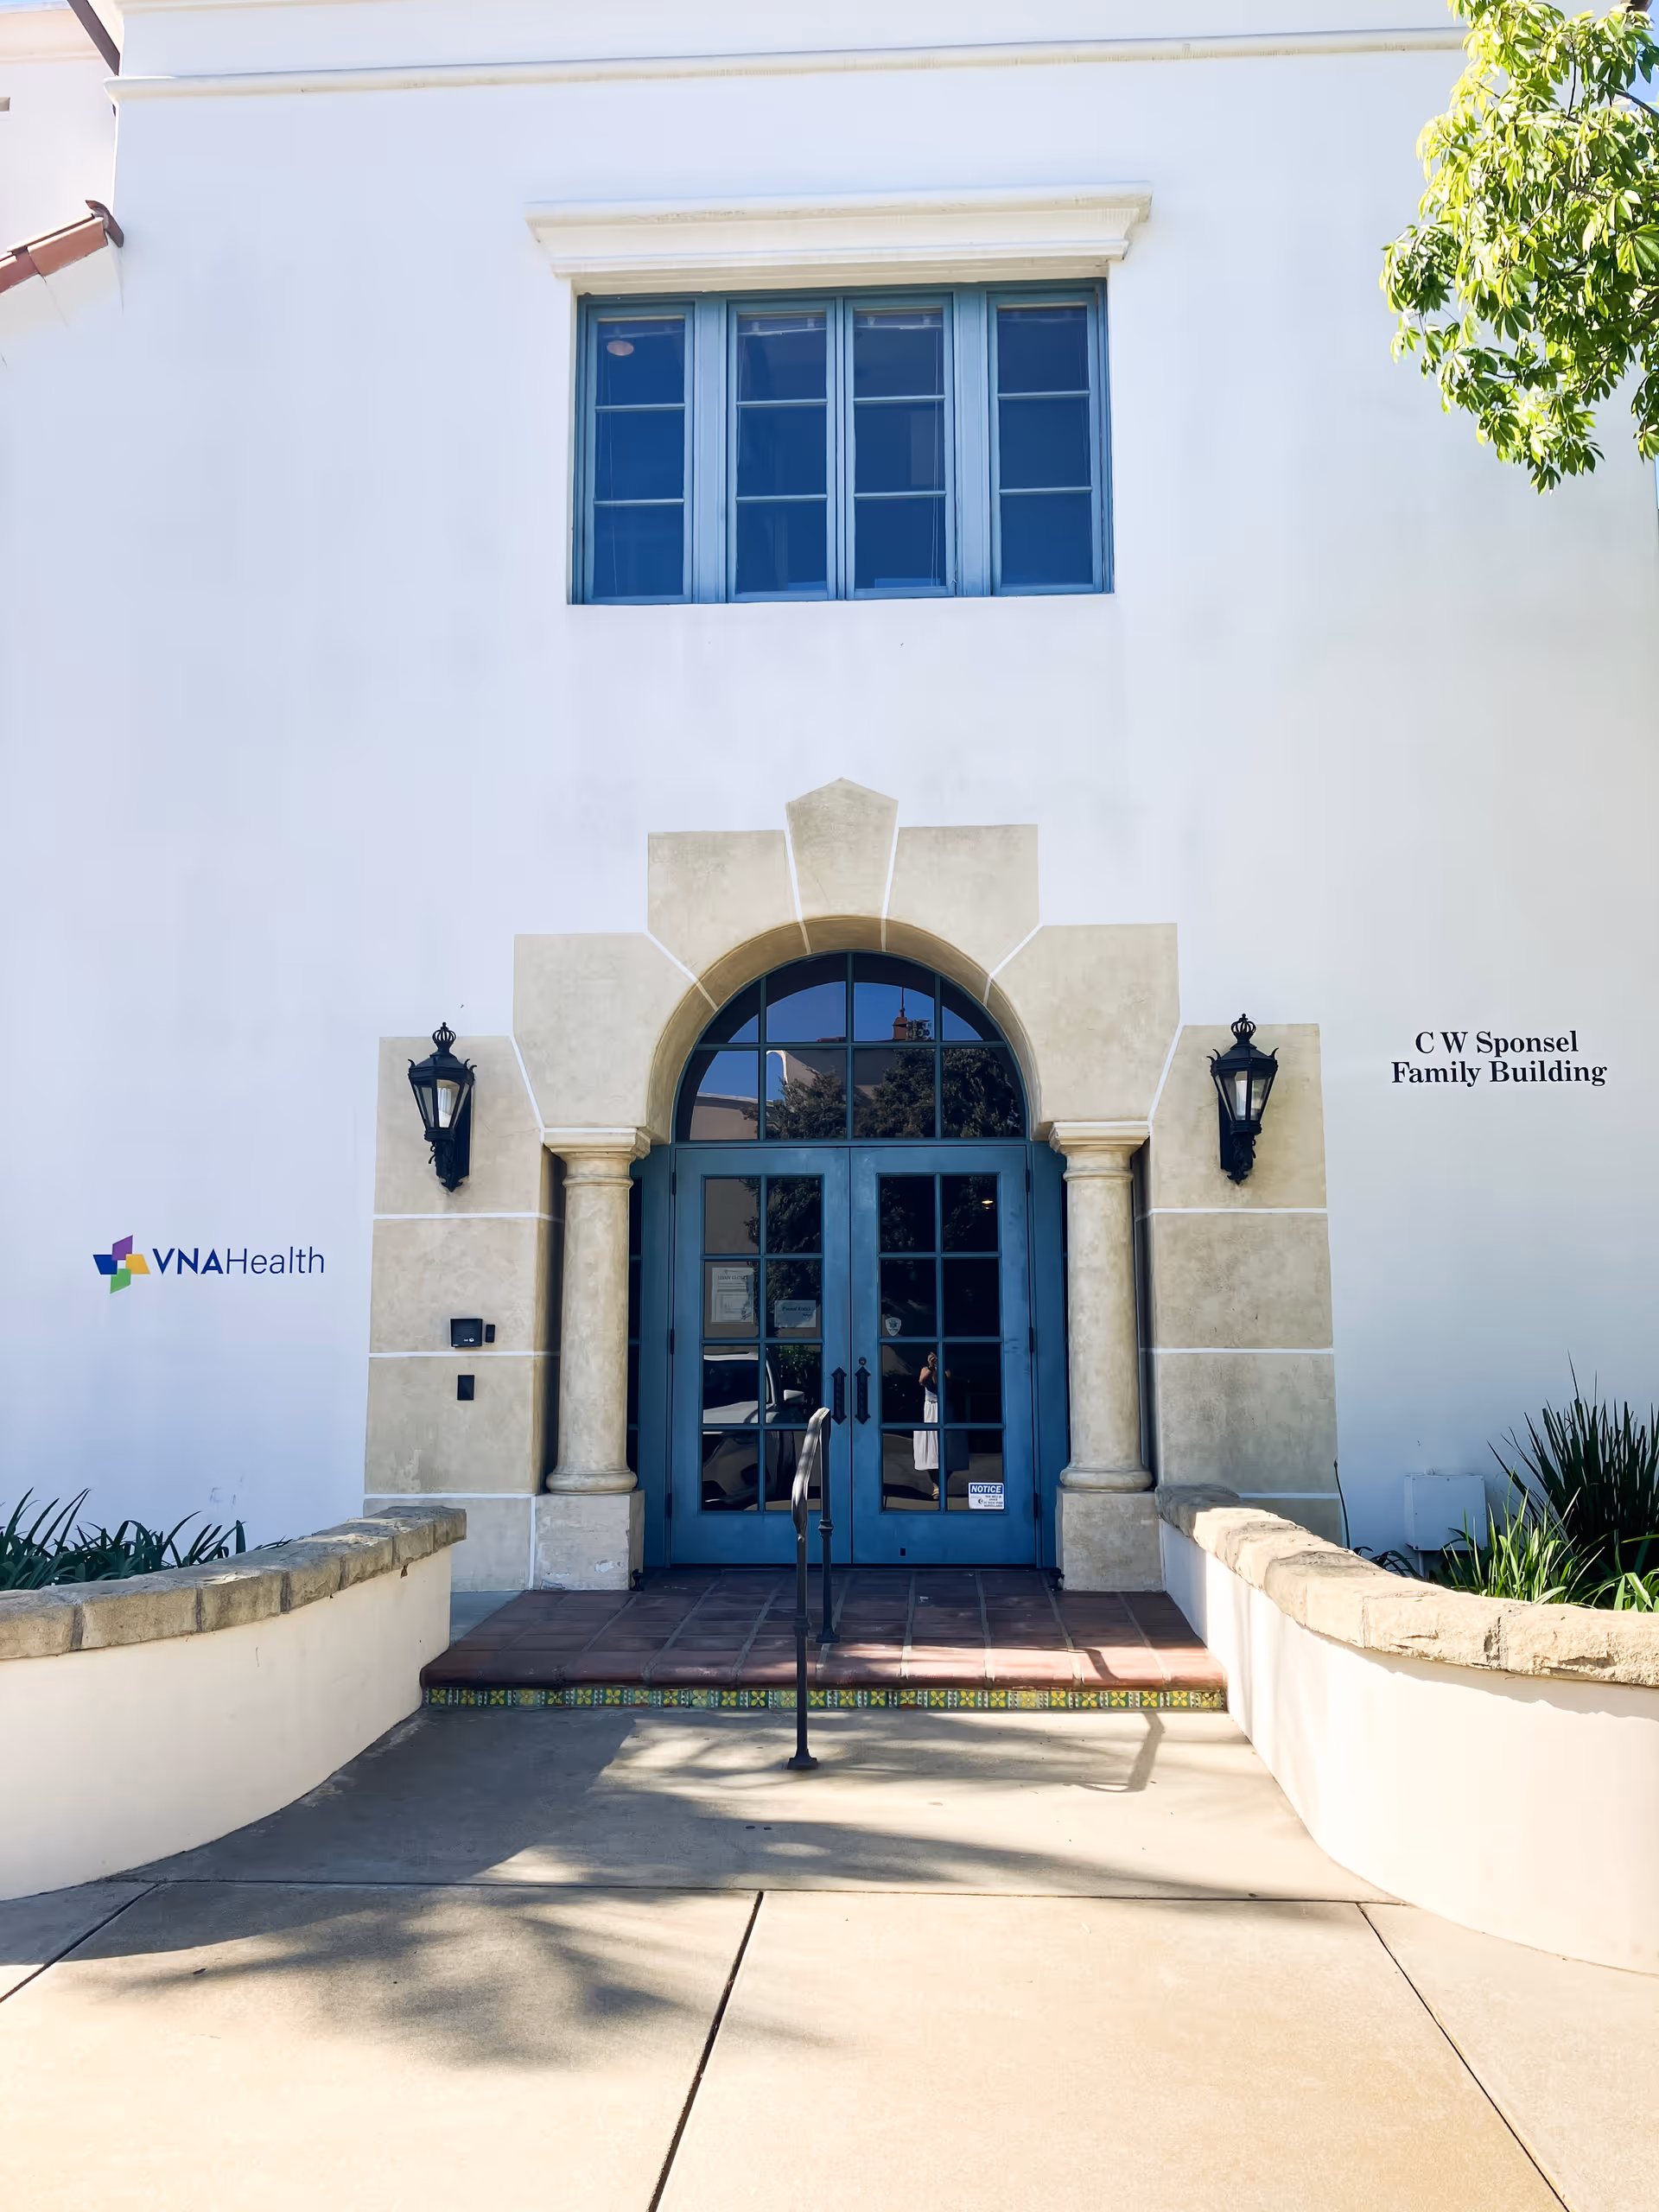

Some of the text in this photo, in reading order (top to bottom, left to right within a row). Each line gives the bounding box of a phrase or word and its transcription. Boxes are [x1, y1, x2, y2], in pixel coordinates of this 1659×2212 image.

[1415, 1030, 1579, 1058] C W Sponsel
[1391, 1059, 1607, 1087] Family Building
[152, 1246, 325, 1274] VNAHealth
[970, 1484, 1002, 1493] NOTICE
